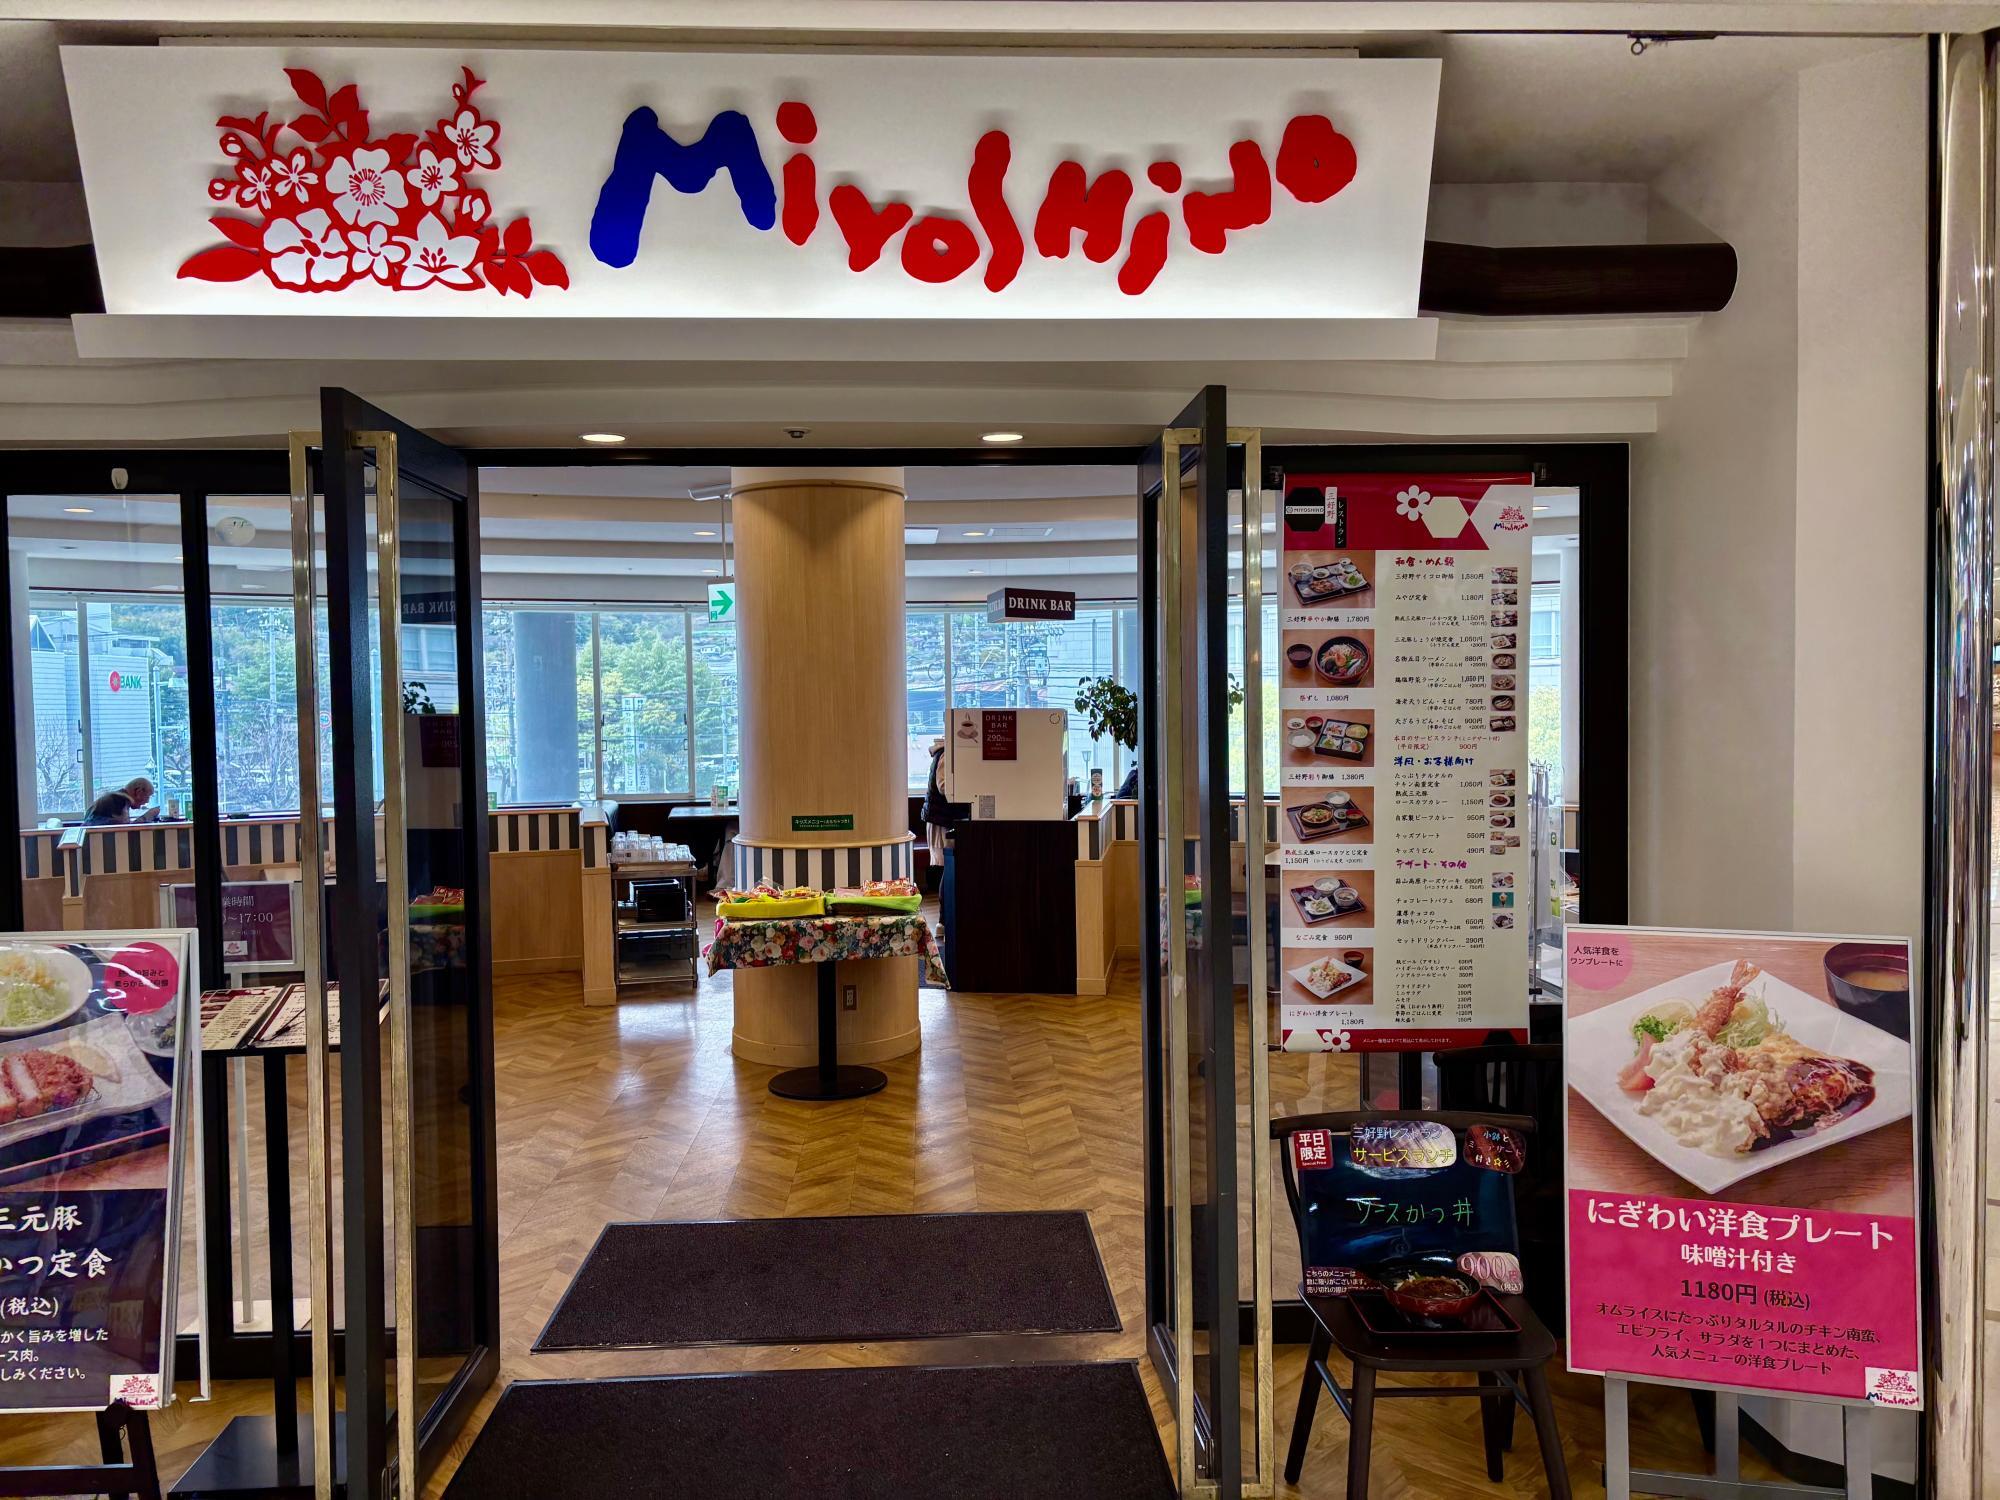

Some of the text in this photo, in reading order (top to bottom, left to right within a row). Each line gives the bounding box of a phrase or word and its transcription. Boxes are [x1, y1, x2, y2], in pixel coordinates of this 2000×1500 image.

[1008, 597, 1047, 610] DRINK
[1050, 599, 1072, 612] BAR
[119, 674, 142, 690] BANK
[1394, 755, 1474, 767] 洋風・お子様向け
[1396, 859, 1467, 869] デザート・その他
[1573, 945, 1619, 956] 人気洋食を
[1570, 957, 1623, 968] ワンプレートに
[1299, 1133, 1325, 1146] 平日
[1353, 1127, 1443, 1140] 三好野レストラン
[1300, 1146, 1327, 1161] 限定
[1353, 1147, 1454, 1164] サービスランチ
[1588, 1198, 1894, 1250] にぎわい洋食プレート
[1681, 1244, 1797, 1274] 味噌汁付き
[1680, 1280, 1811, 1310] 1180円 (税込)
[1651, 1344, 1831, 1375] 人気メニューの洋食プレート
